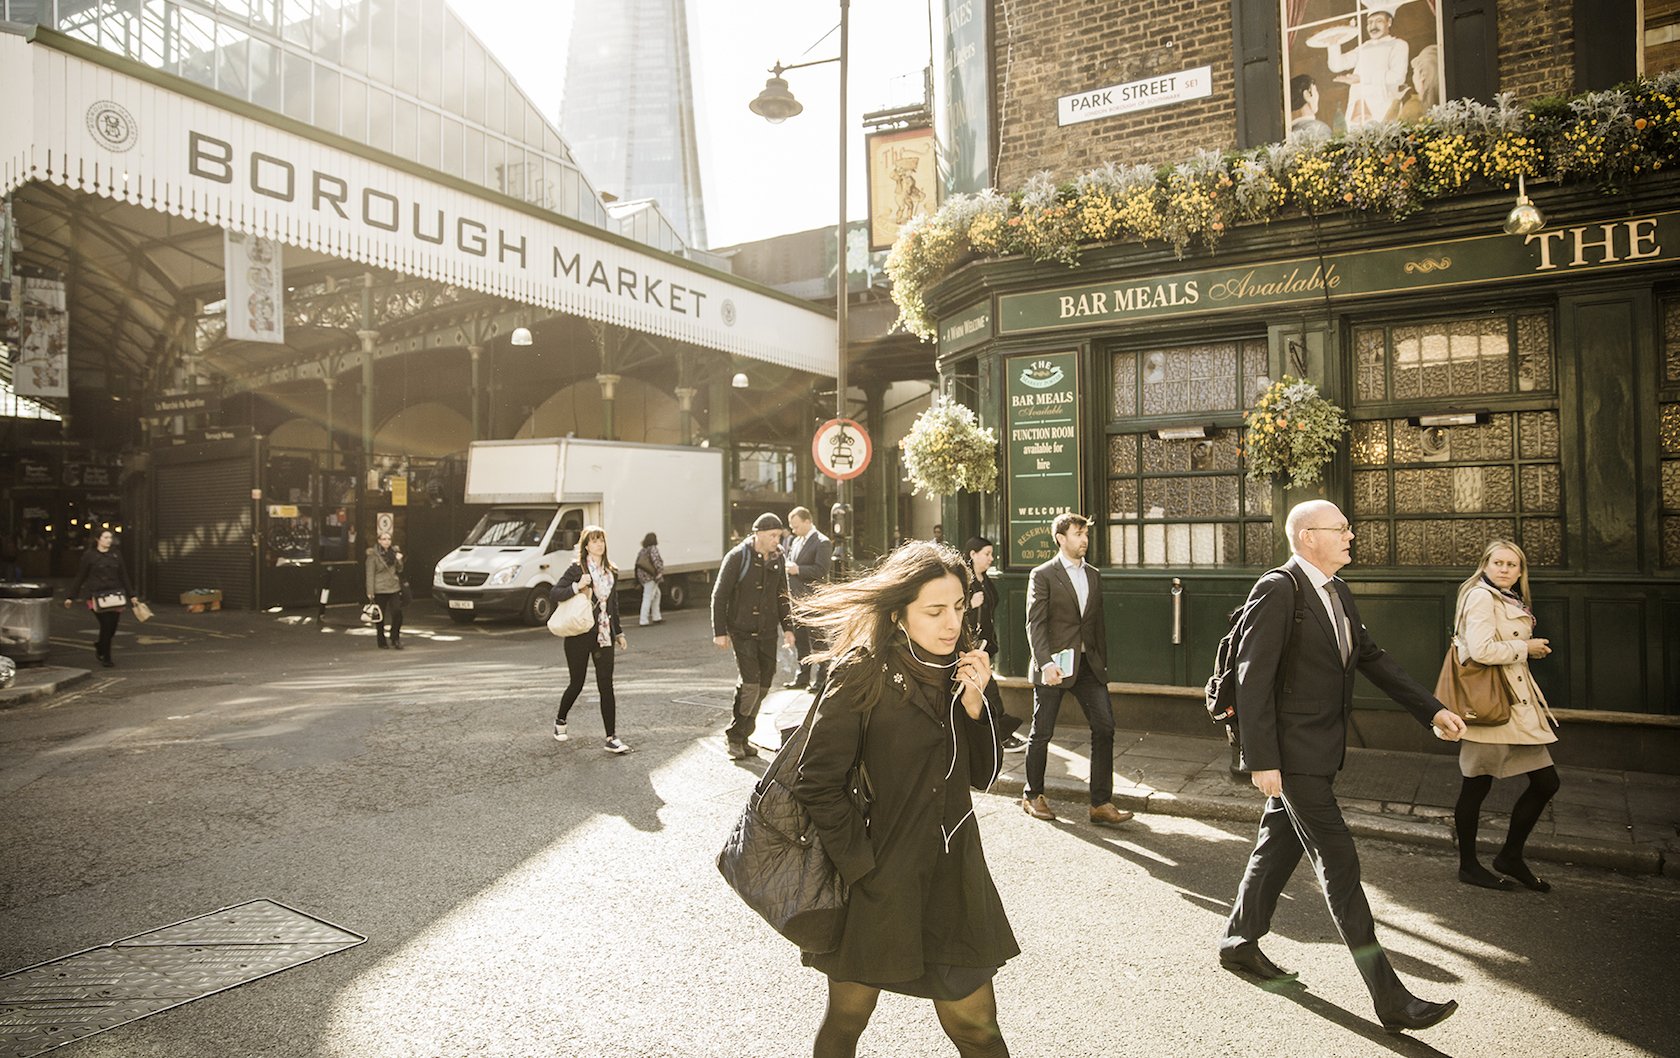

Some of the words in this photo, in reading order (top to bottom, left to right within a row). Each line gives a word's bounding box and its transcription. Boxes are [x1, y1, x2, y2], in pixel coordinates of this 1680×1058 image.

[1071, 91, 1113, 112] PARK
[1122, 77, 1177, 101] STREET
[1184, 78, 1199, 89] SE1
[188, 130, 526, 268] BOROUGH
[553, 246, 708, 319] MARKET
[1524, 218, 1662, 270] THE
[1059, 292, 1108, 318] BAR
[1113, 280, 1200, 312] MEALS
[1208, 264, 1342, 300] Available
[1030, 360, 1052, 371] THE
[1012, 395, 1034, 407] BAR
[1036, 391, 1073, 405] MEALS
[1018, 405, 1063, 417] Available
[1012, 427, 1050, 441] FUNCTION
[1051, 426, 1075, 439] ROOM
[1023, 442, 1052, 455] available
[1053, 441, 1064, 453] for
[1036, 458, 1051, 470] hire
[1018, 506, 1071, 516] WELCOME
[1018, 526, 1053, 546] RESERVA
